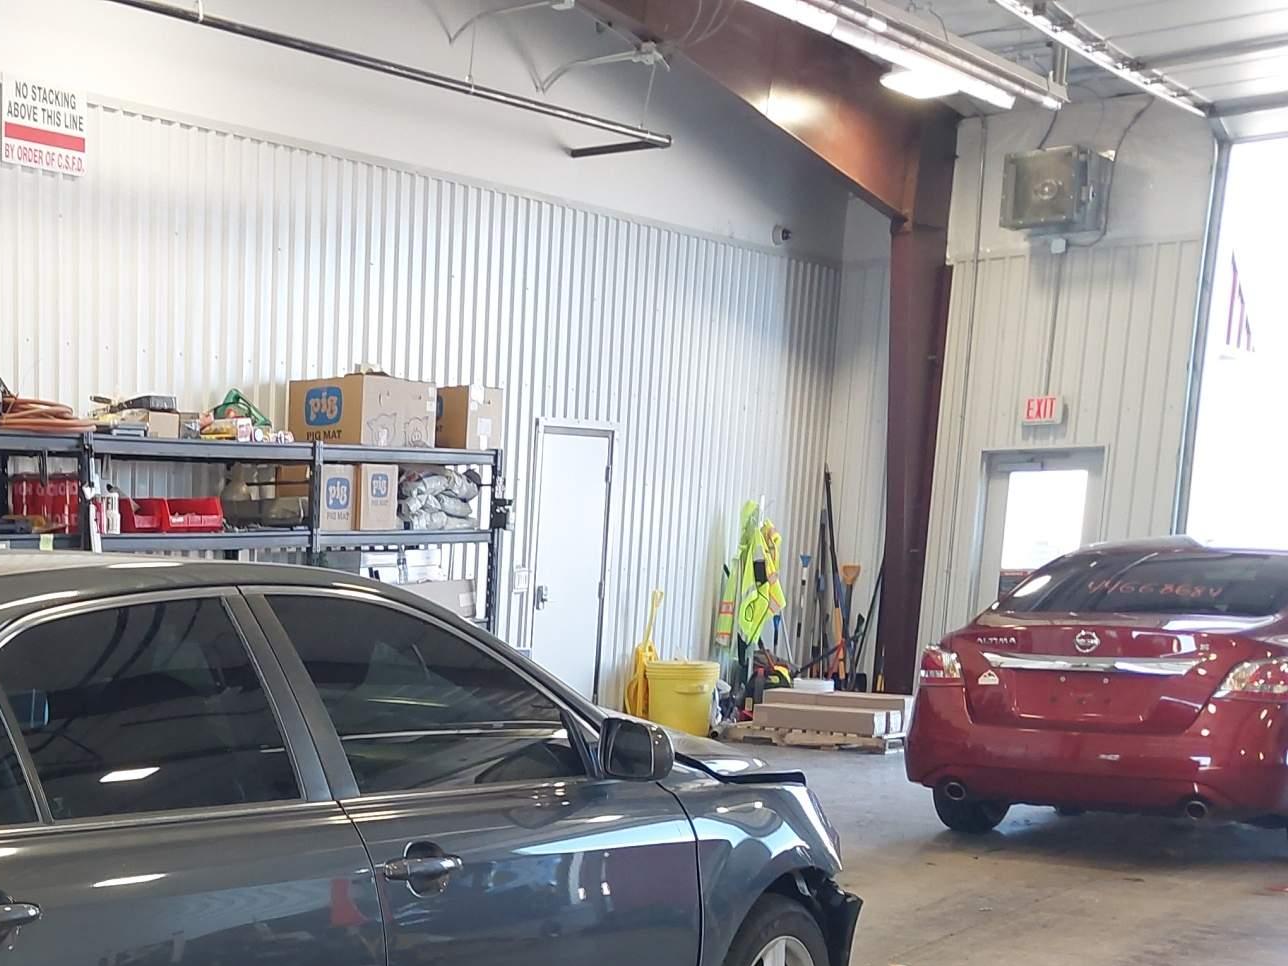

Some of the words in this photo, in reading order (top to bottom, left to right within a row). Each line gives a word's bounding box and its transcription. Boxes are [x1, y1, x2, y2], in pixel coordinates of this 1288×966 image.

[15, 80, 28, 99] NO
[31, 84, 76, 110] STACKING
[7, 101, 38, 122] ABOVE
[41, 108, 62, 127] THIS
[64, 113, 84, 132] LINE
[4, 143, 16, 158] BY
[17, 146, 44, 165] ORDER
[45, 151, 55, 167] OF
[309, 391, 338, 420] pig
[1026, 397, 1057, 420] EXIT
[306, 431, 322, 441] PIG
[323, 430, 343, 441] MAT
[328, 480, 348, 506] pig
